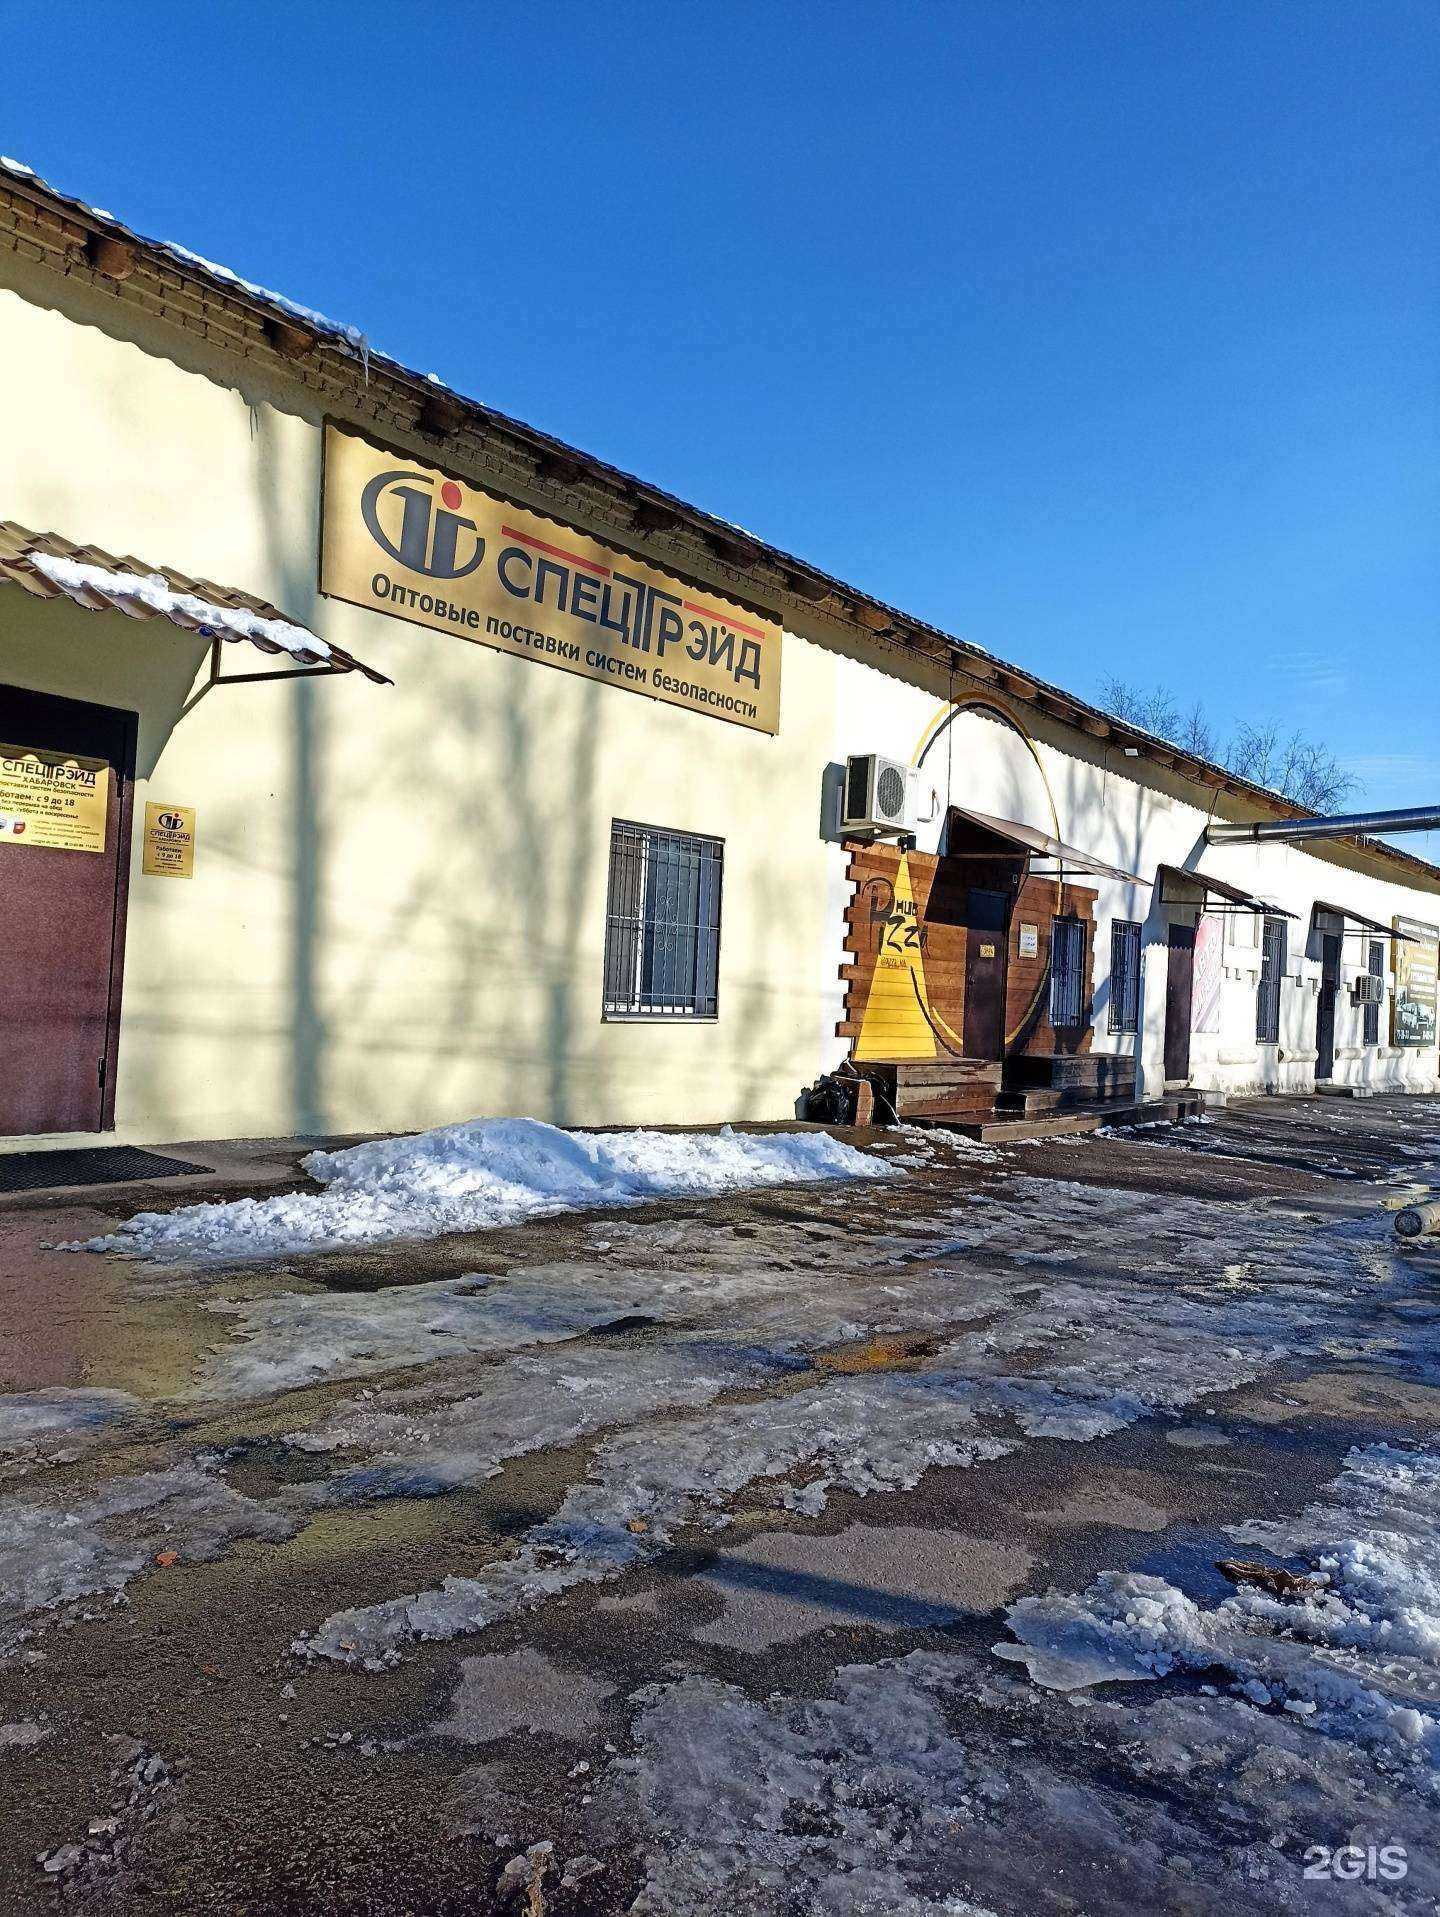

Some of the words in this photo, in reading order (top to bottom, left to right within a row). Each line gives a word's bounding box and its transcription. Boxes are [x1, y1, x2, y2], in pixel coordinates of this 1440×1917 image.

[497, 547, 761, 690] СПЕЦТРЭЙД
[372, 573, 479, 629] Оптовые
[486, 617, 580, 663] поставки
[585, 648, 647, 684] систем
[652, 668, 757, 719] безопасности
[22, 776, 76, 790] ХАБАРОВСК
[51, 798, 62, 806] до
[64, 798, 75, 807] 18
[896, 900, 918, 916] HUB
